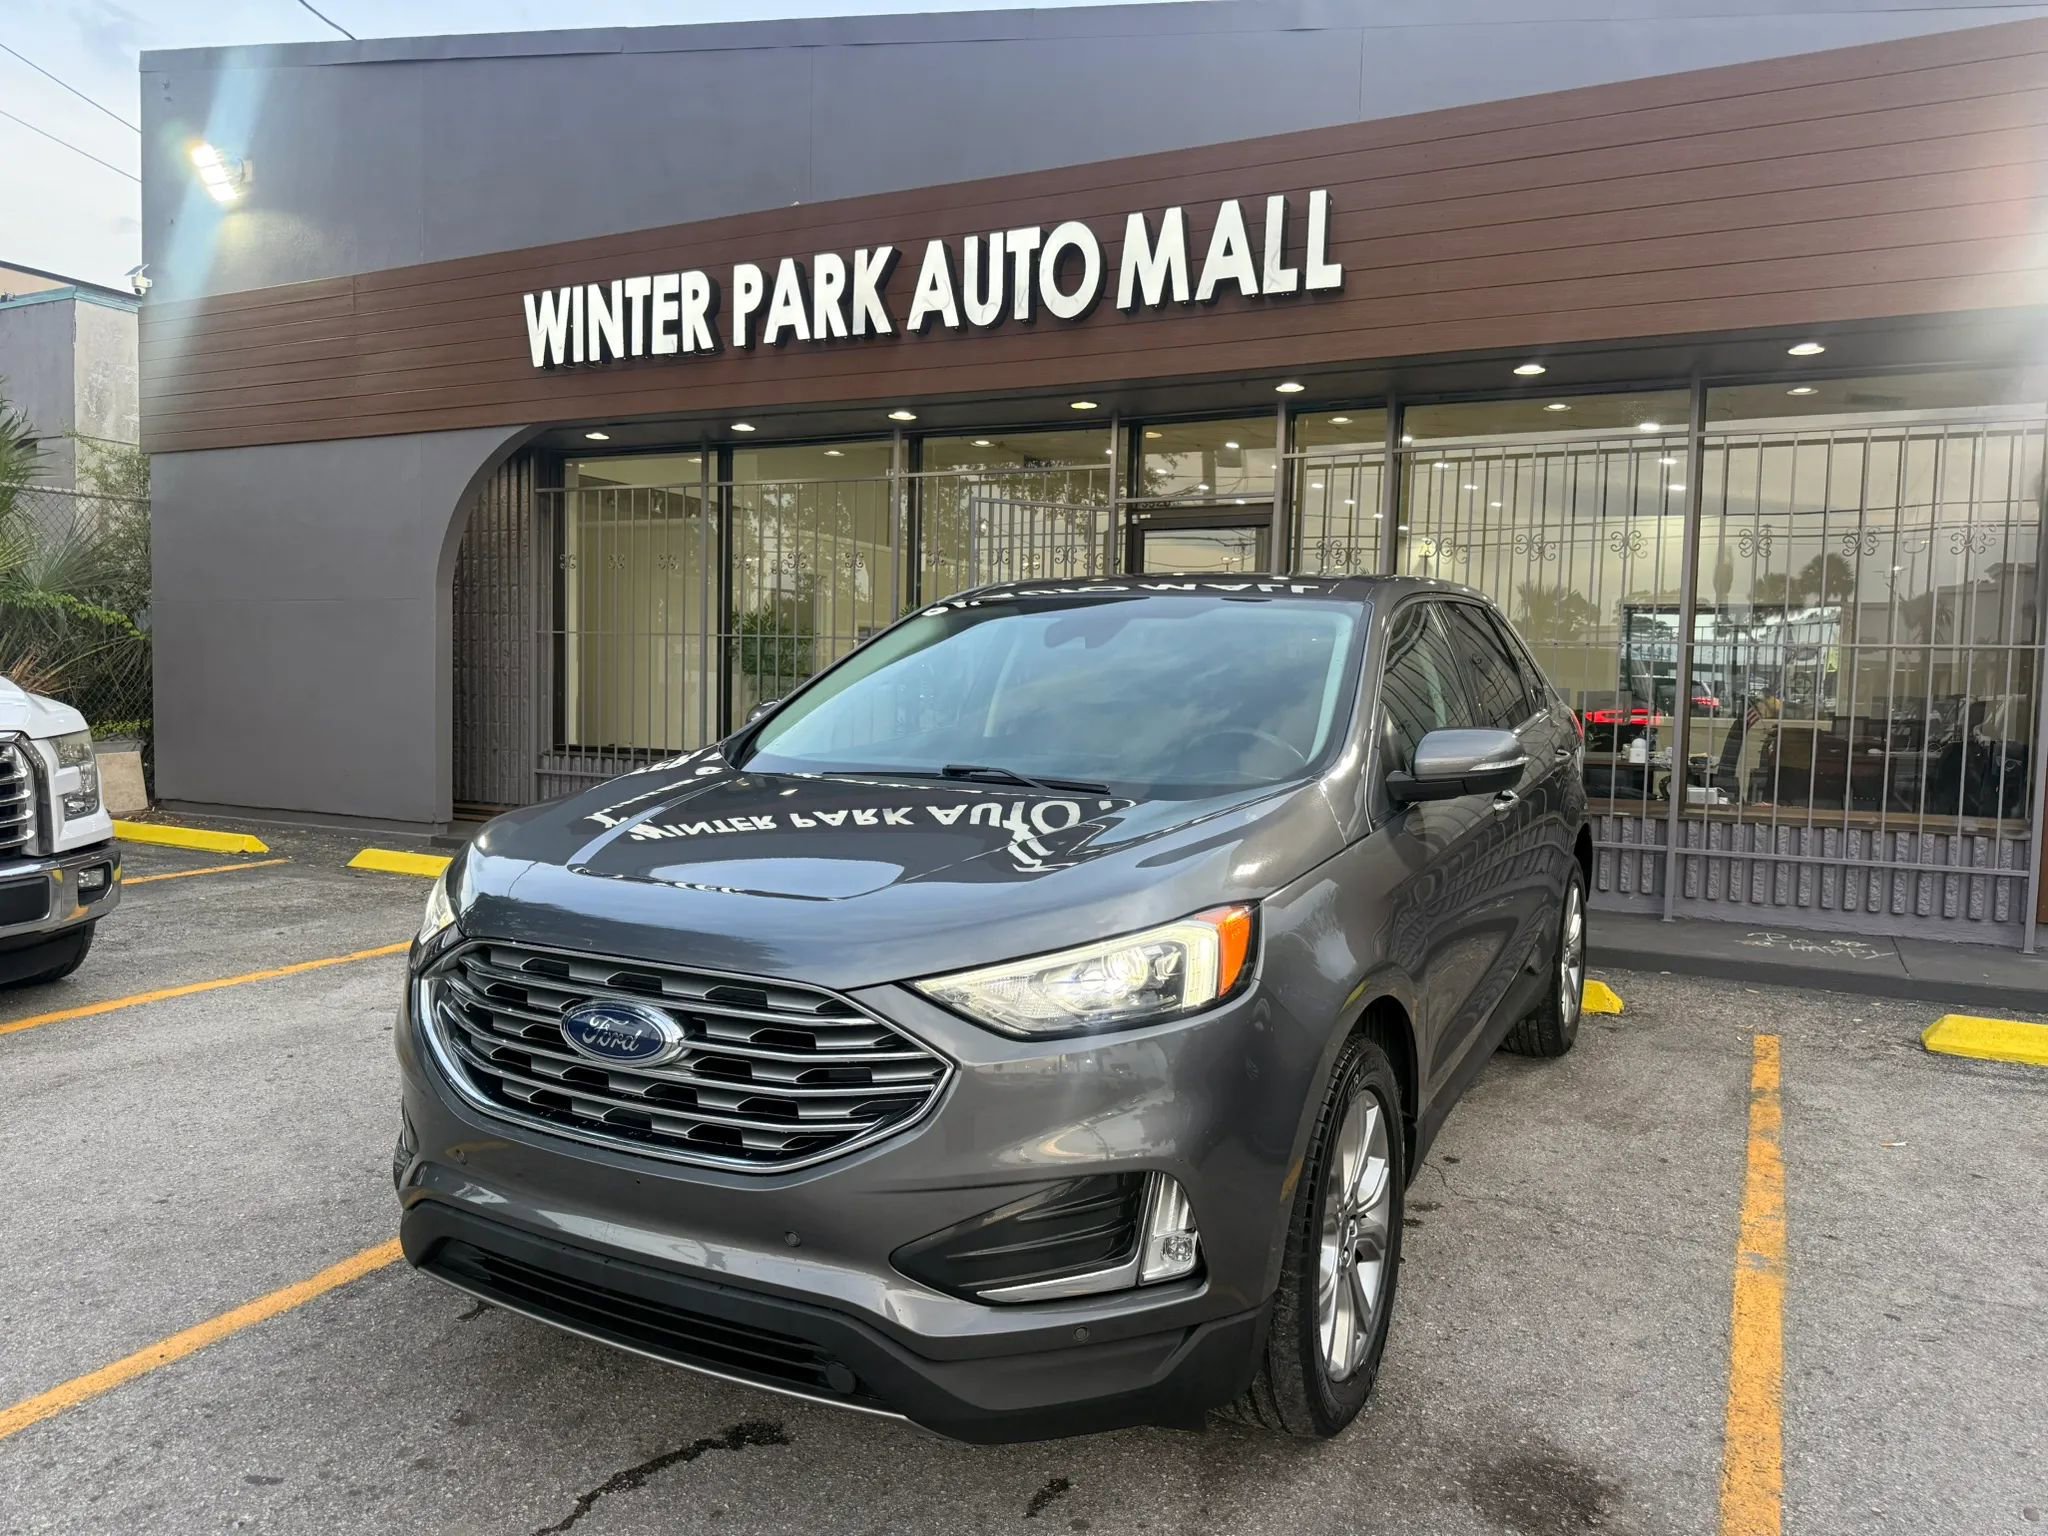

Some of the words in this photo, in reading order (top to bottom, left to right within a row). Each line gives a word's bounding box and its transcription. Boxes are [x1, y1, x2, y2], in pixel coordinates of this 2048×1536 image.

[524, 270, 715, 369] WINTER
[732, 246, 895, 349] PARK
[907, 220, 1102, 333] AUTO
[1116, 189, 1343, 310] MALL
[581, 1013, 643, 1052] Ford
